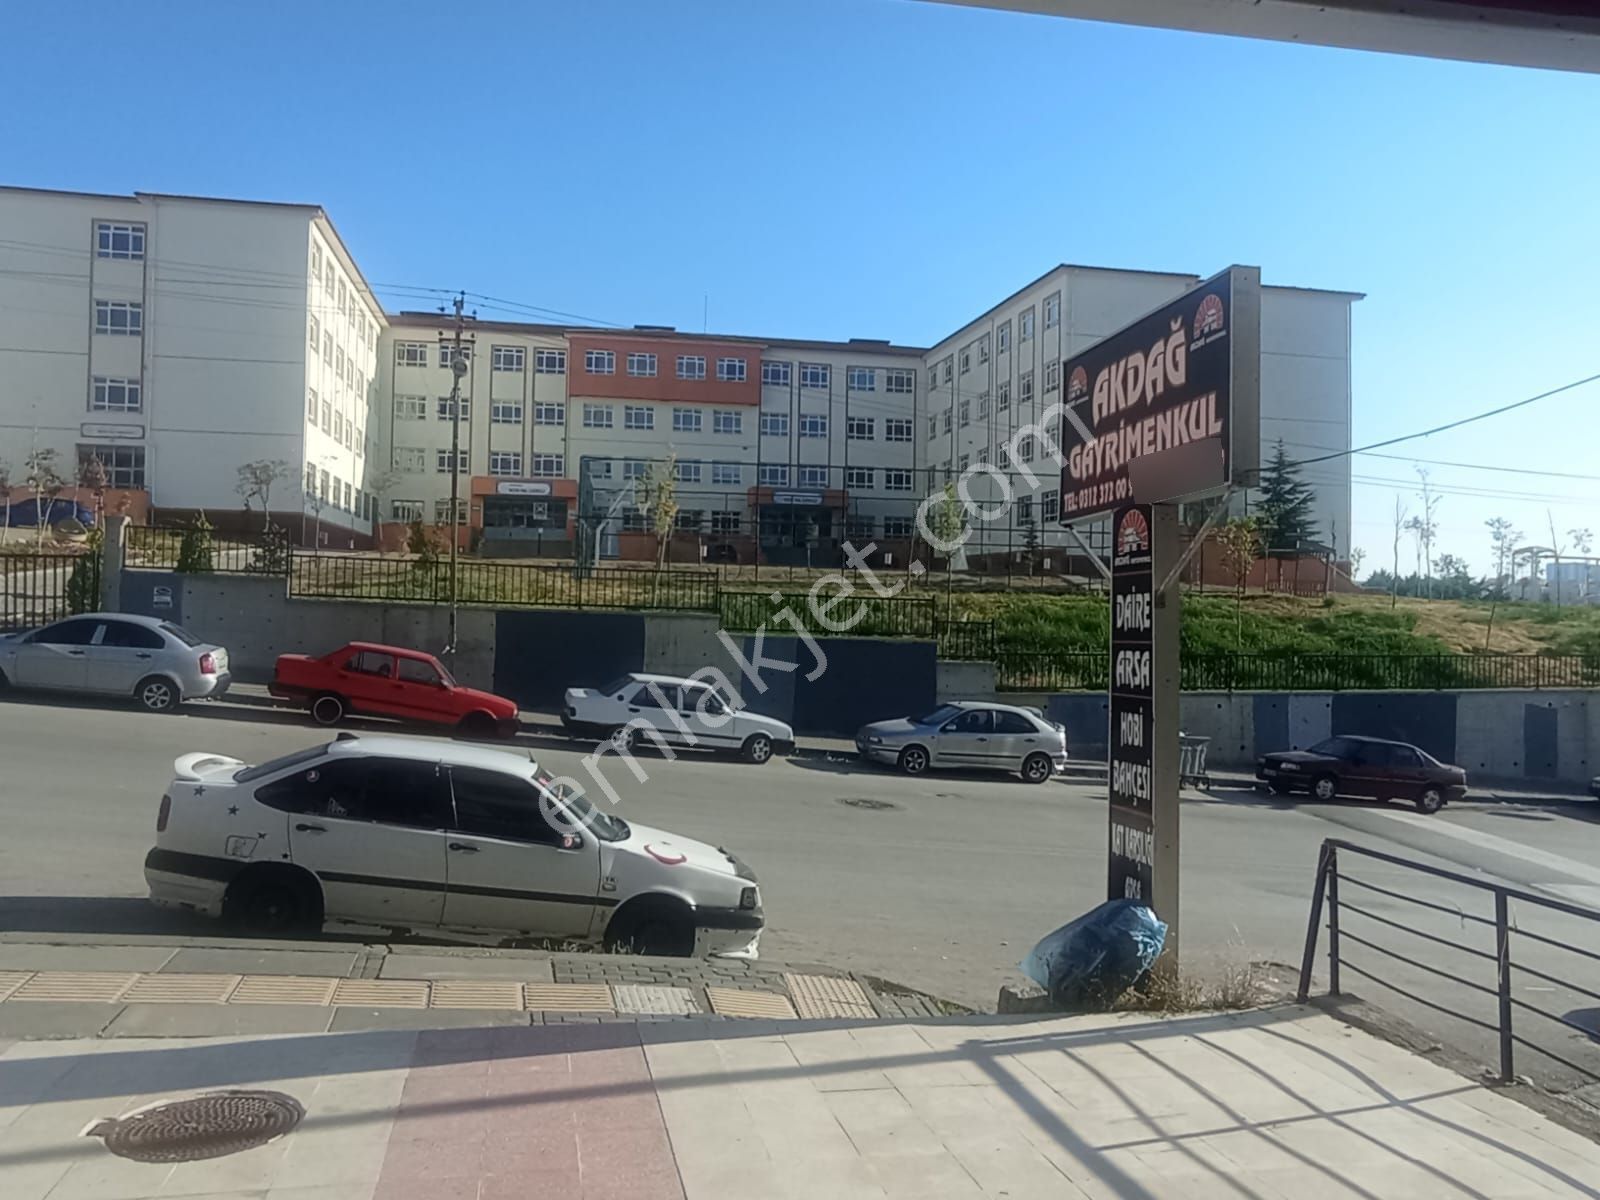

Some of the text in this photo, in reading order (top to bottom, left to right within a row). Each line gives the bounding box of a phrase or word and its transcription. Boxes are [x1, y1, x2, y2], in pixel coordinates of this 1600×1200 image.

[1092, 315, 1186, 427] AKDAĞ
[1070, 391, 1223, 480] GAYRİMENKUL
[1116, 585, 1150, 632] DAİRE
[1116, 650, 1150, 690] ARSA
[1120, 706, 1143, 748] HOBİ
[1113, 759, 1150, 807] BAHÇESİ
